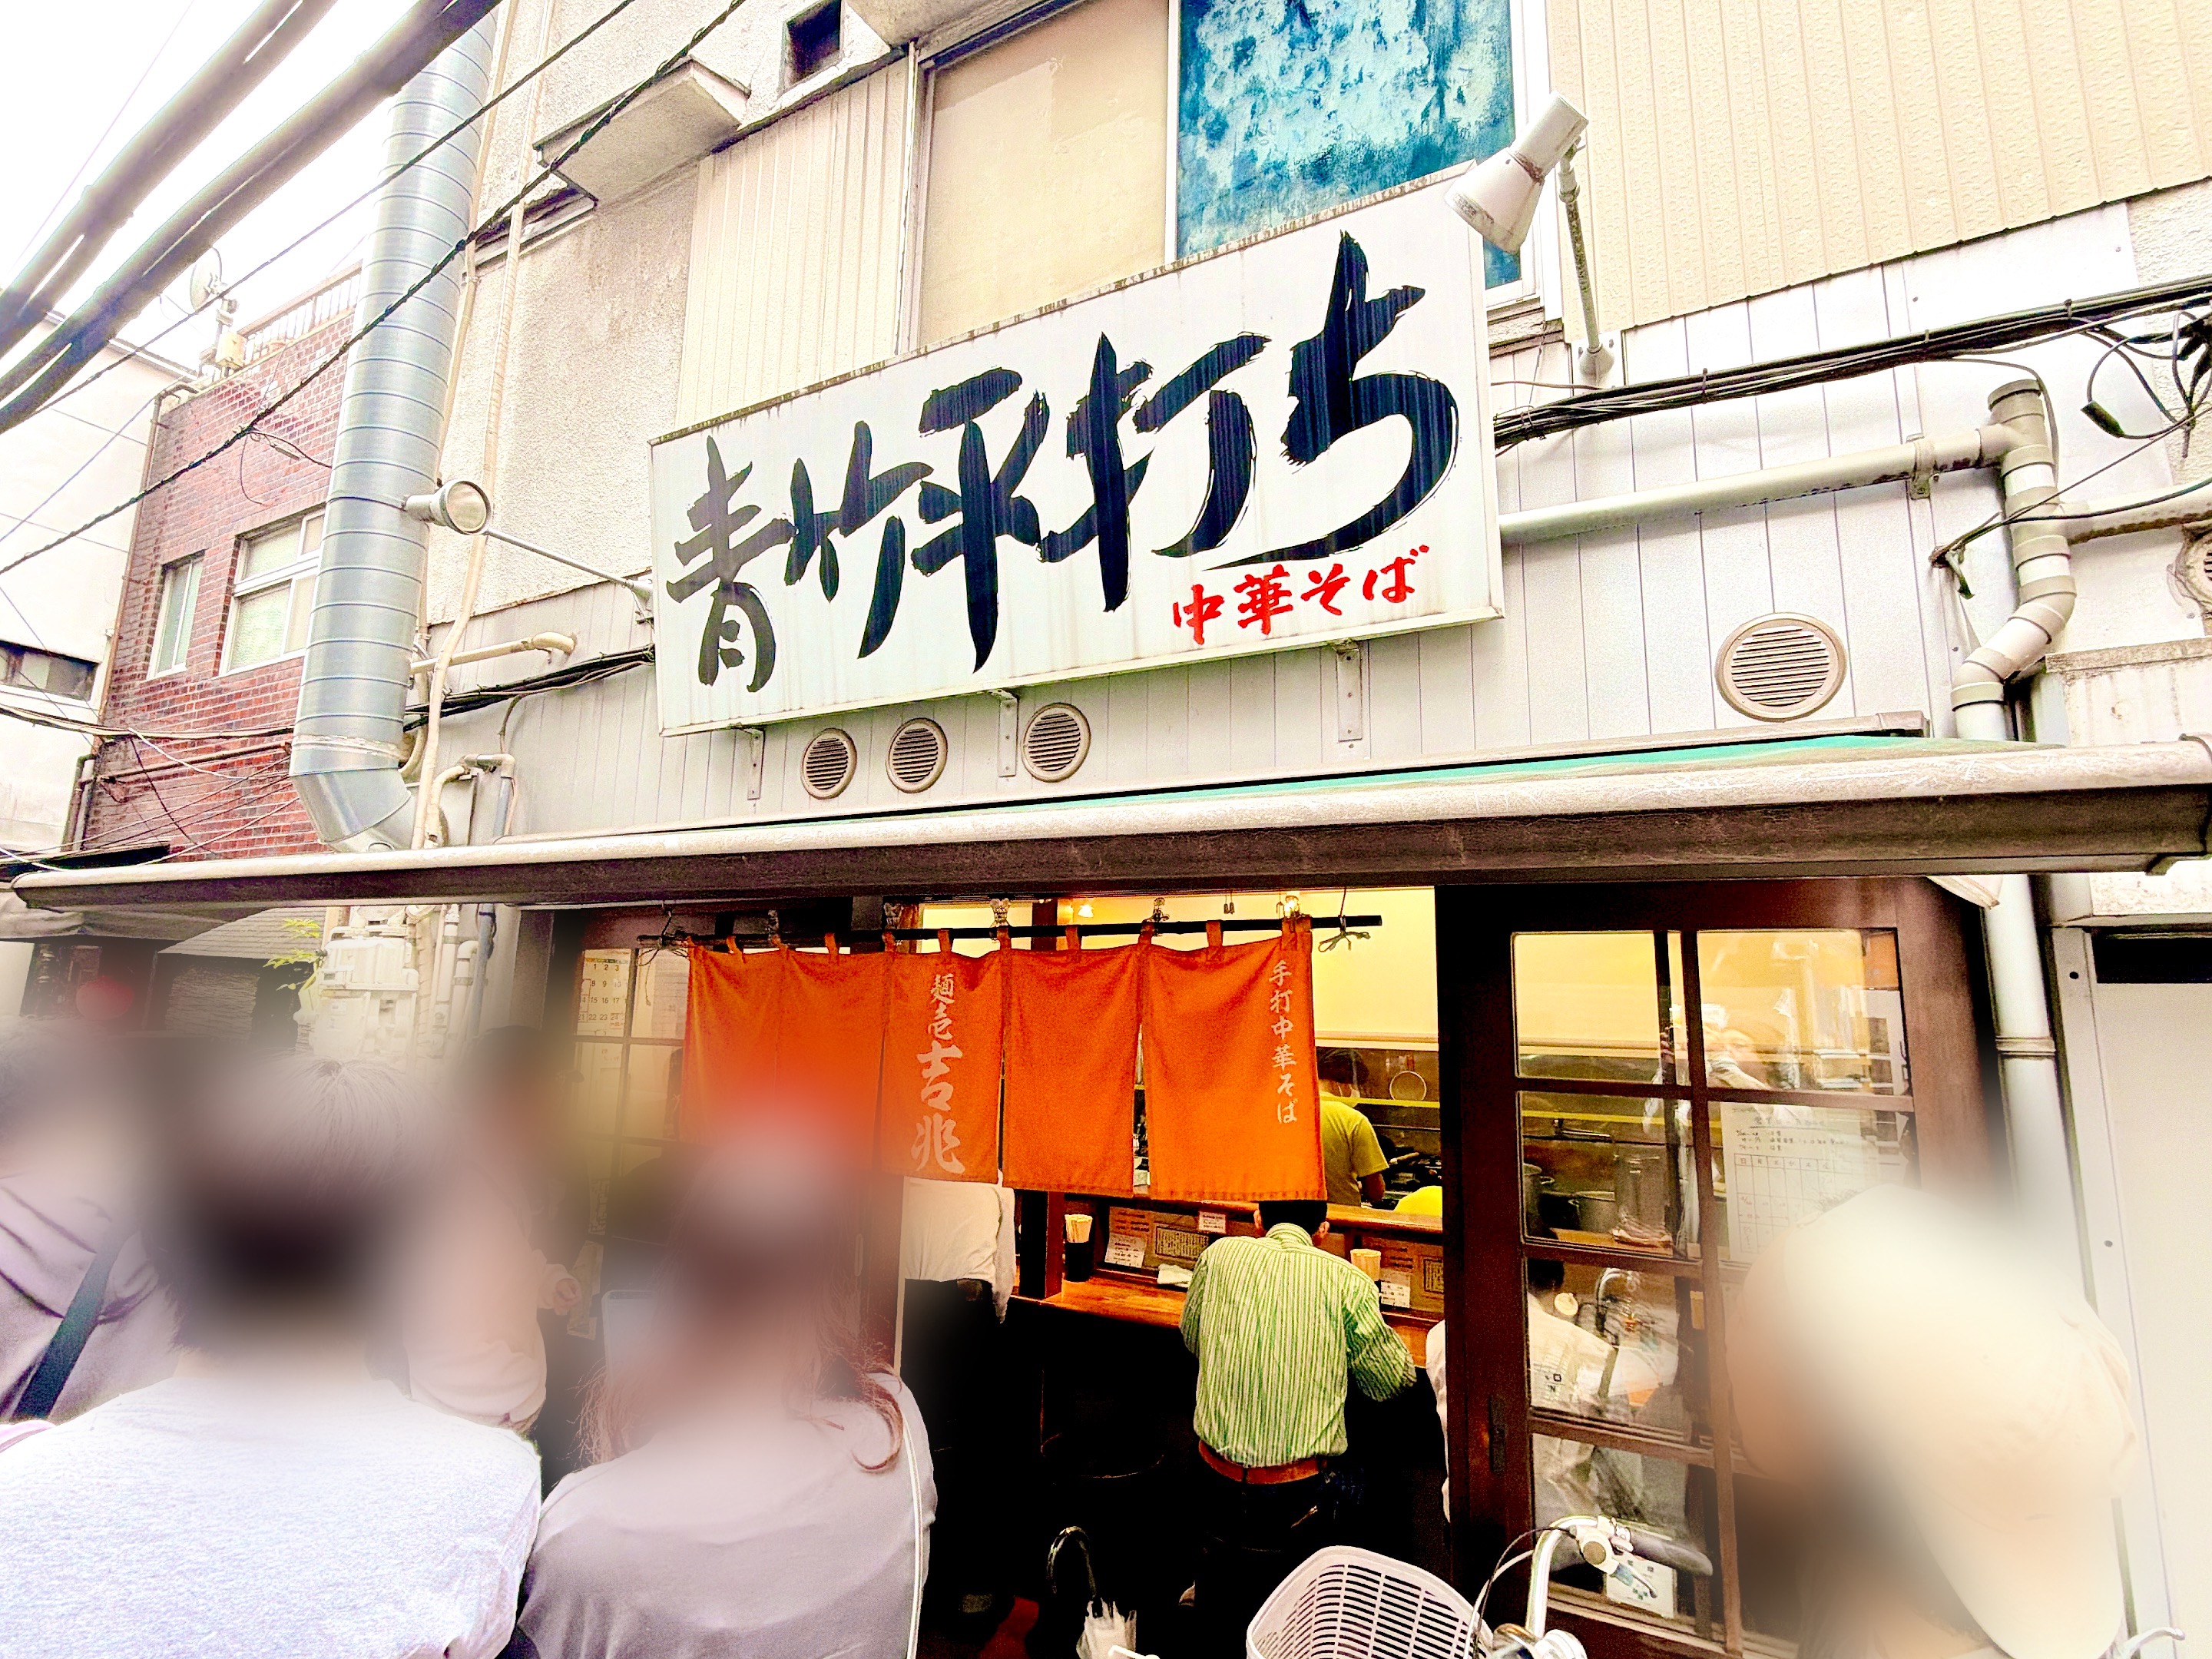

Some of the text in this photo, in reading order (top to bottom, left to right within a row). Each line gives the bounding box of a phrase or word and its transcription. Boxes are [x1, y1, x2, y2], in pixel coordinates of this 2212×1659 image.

[666, 231, 1458, 693] 青竹平打ち
[1173, 545, 1430, 647] 中華そば
[1269, 959, 1298, 1124] 手打中華そば
